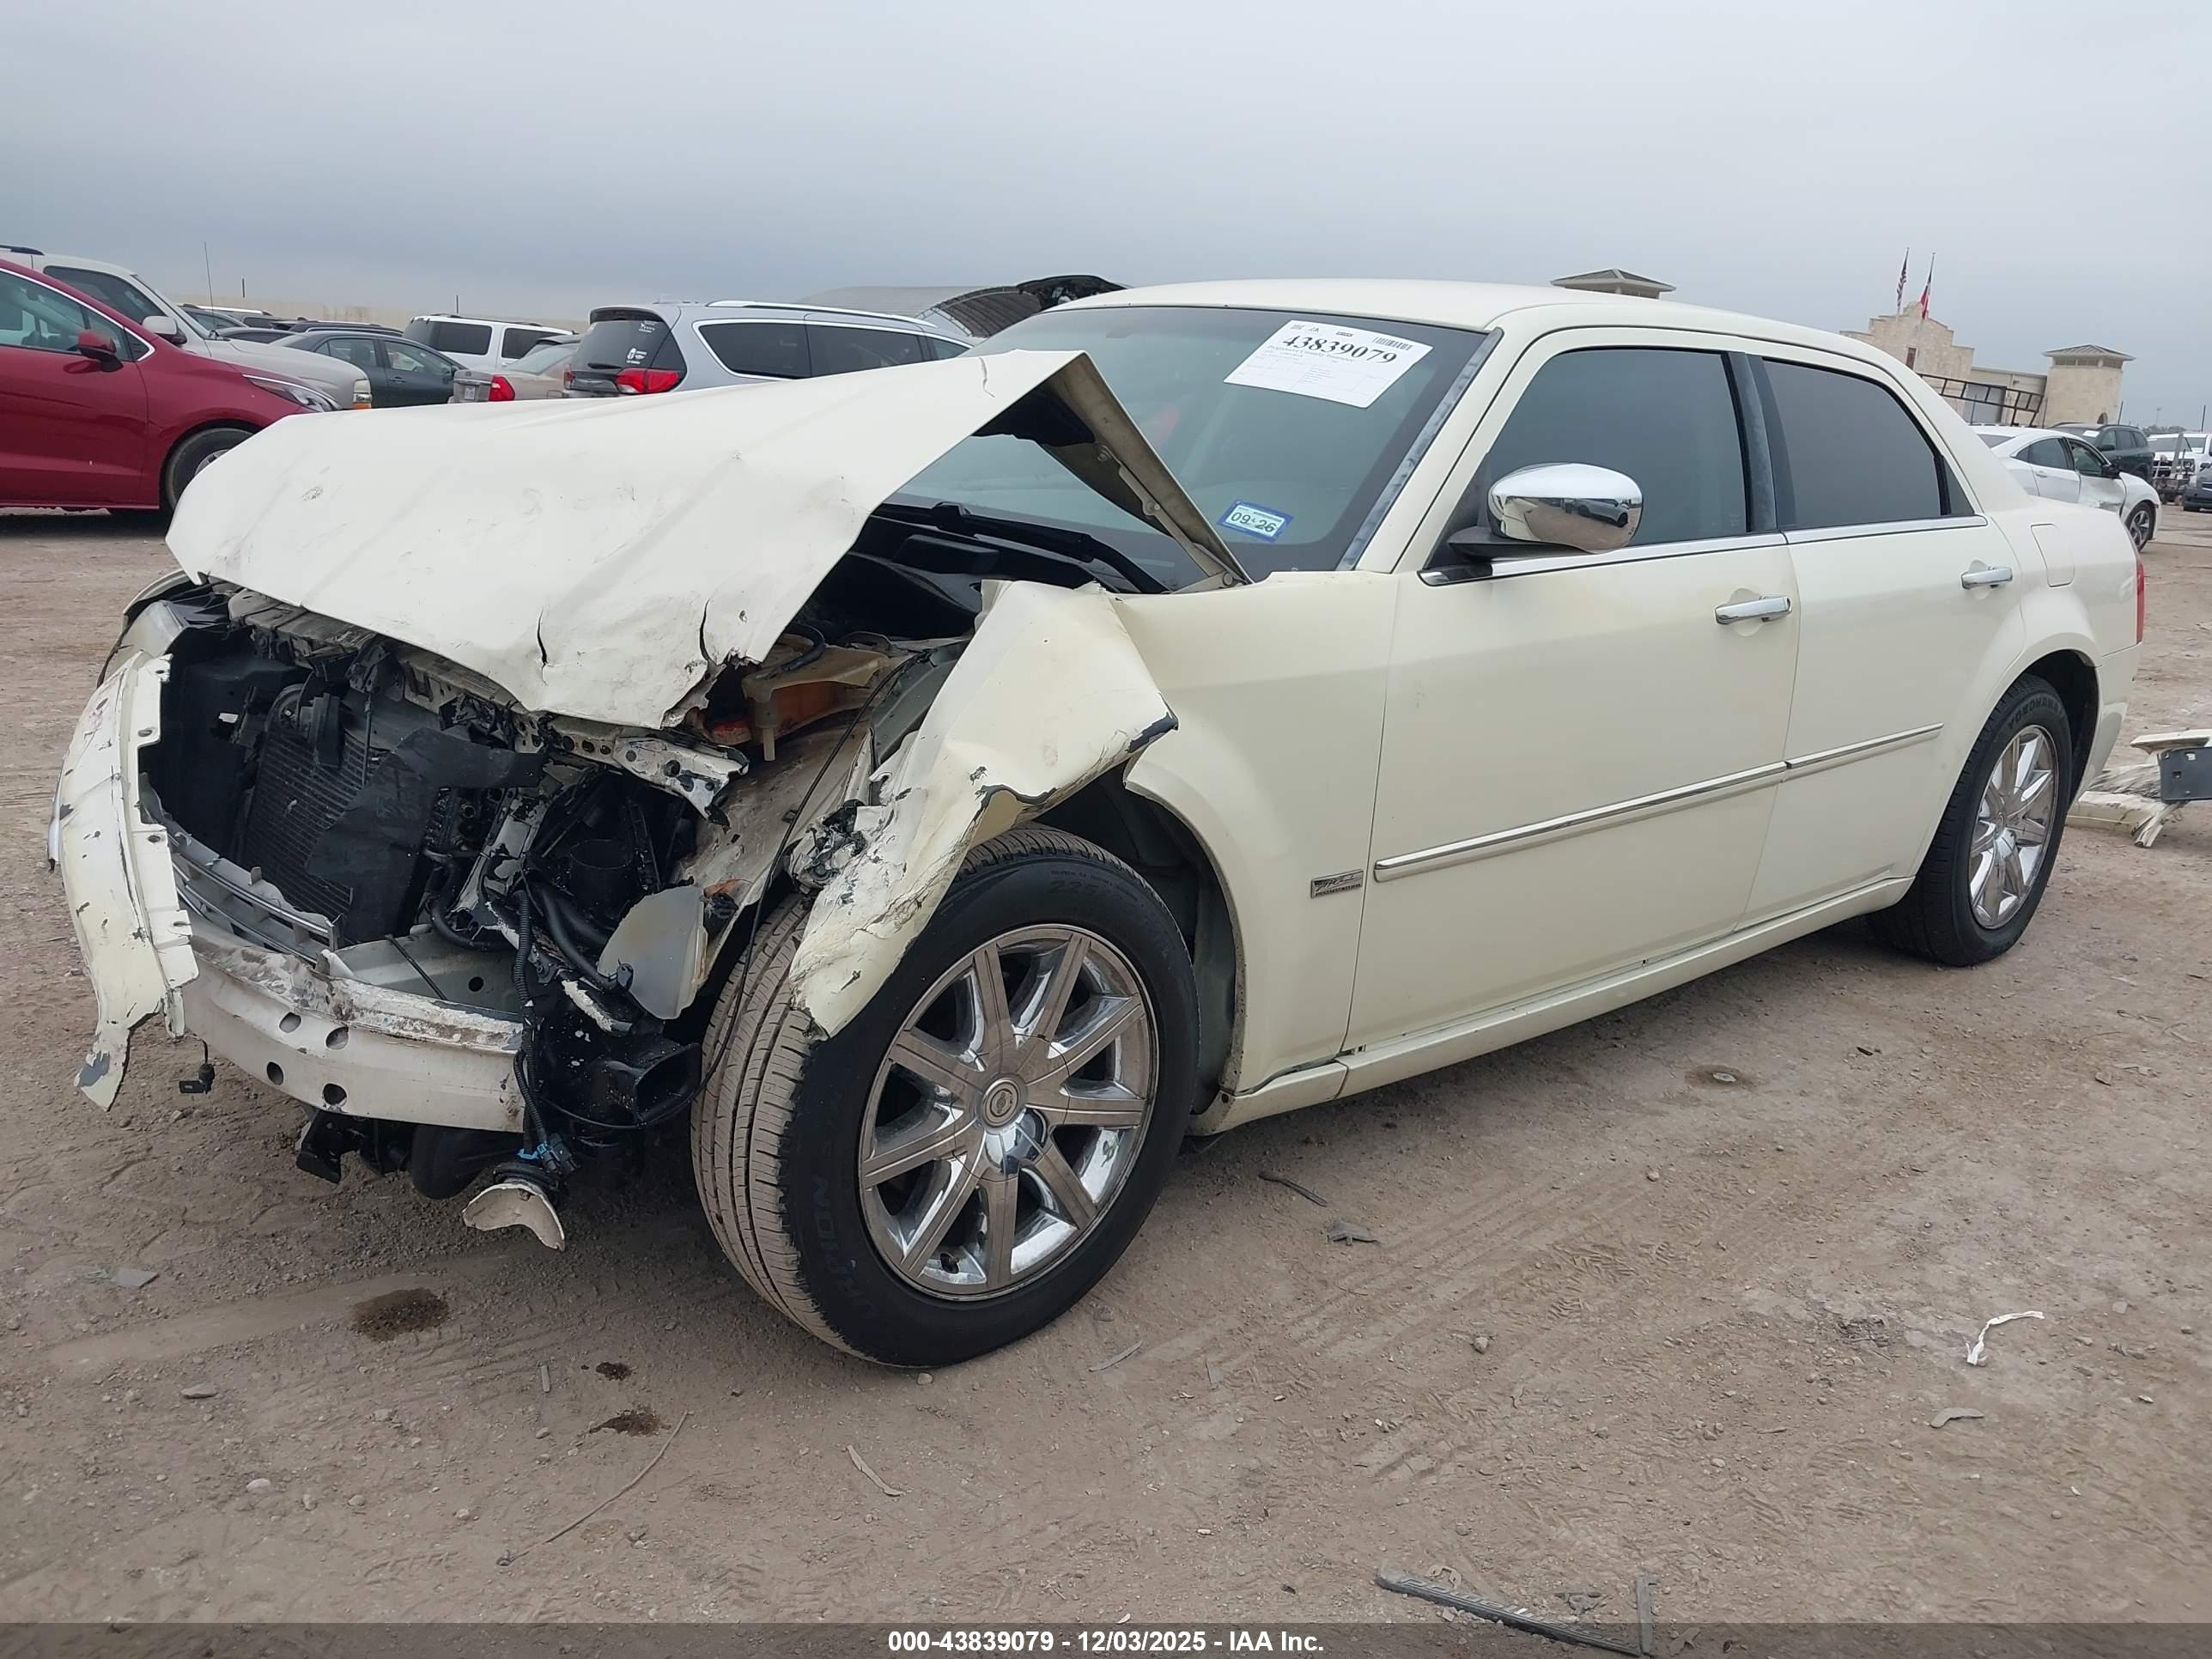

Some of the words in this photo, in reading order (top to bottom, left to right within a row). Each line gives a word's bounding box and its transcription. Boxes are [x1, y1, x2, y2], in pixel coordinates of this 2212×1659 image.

[1282, 334, 1399, 364] 43839079
[1231, 512, 1251, 525] 09
[1255, 519, 1277, 533] 26
